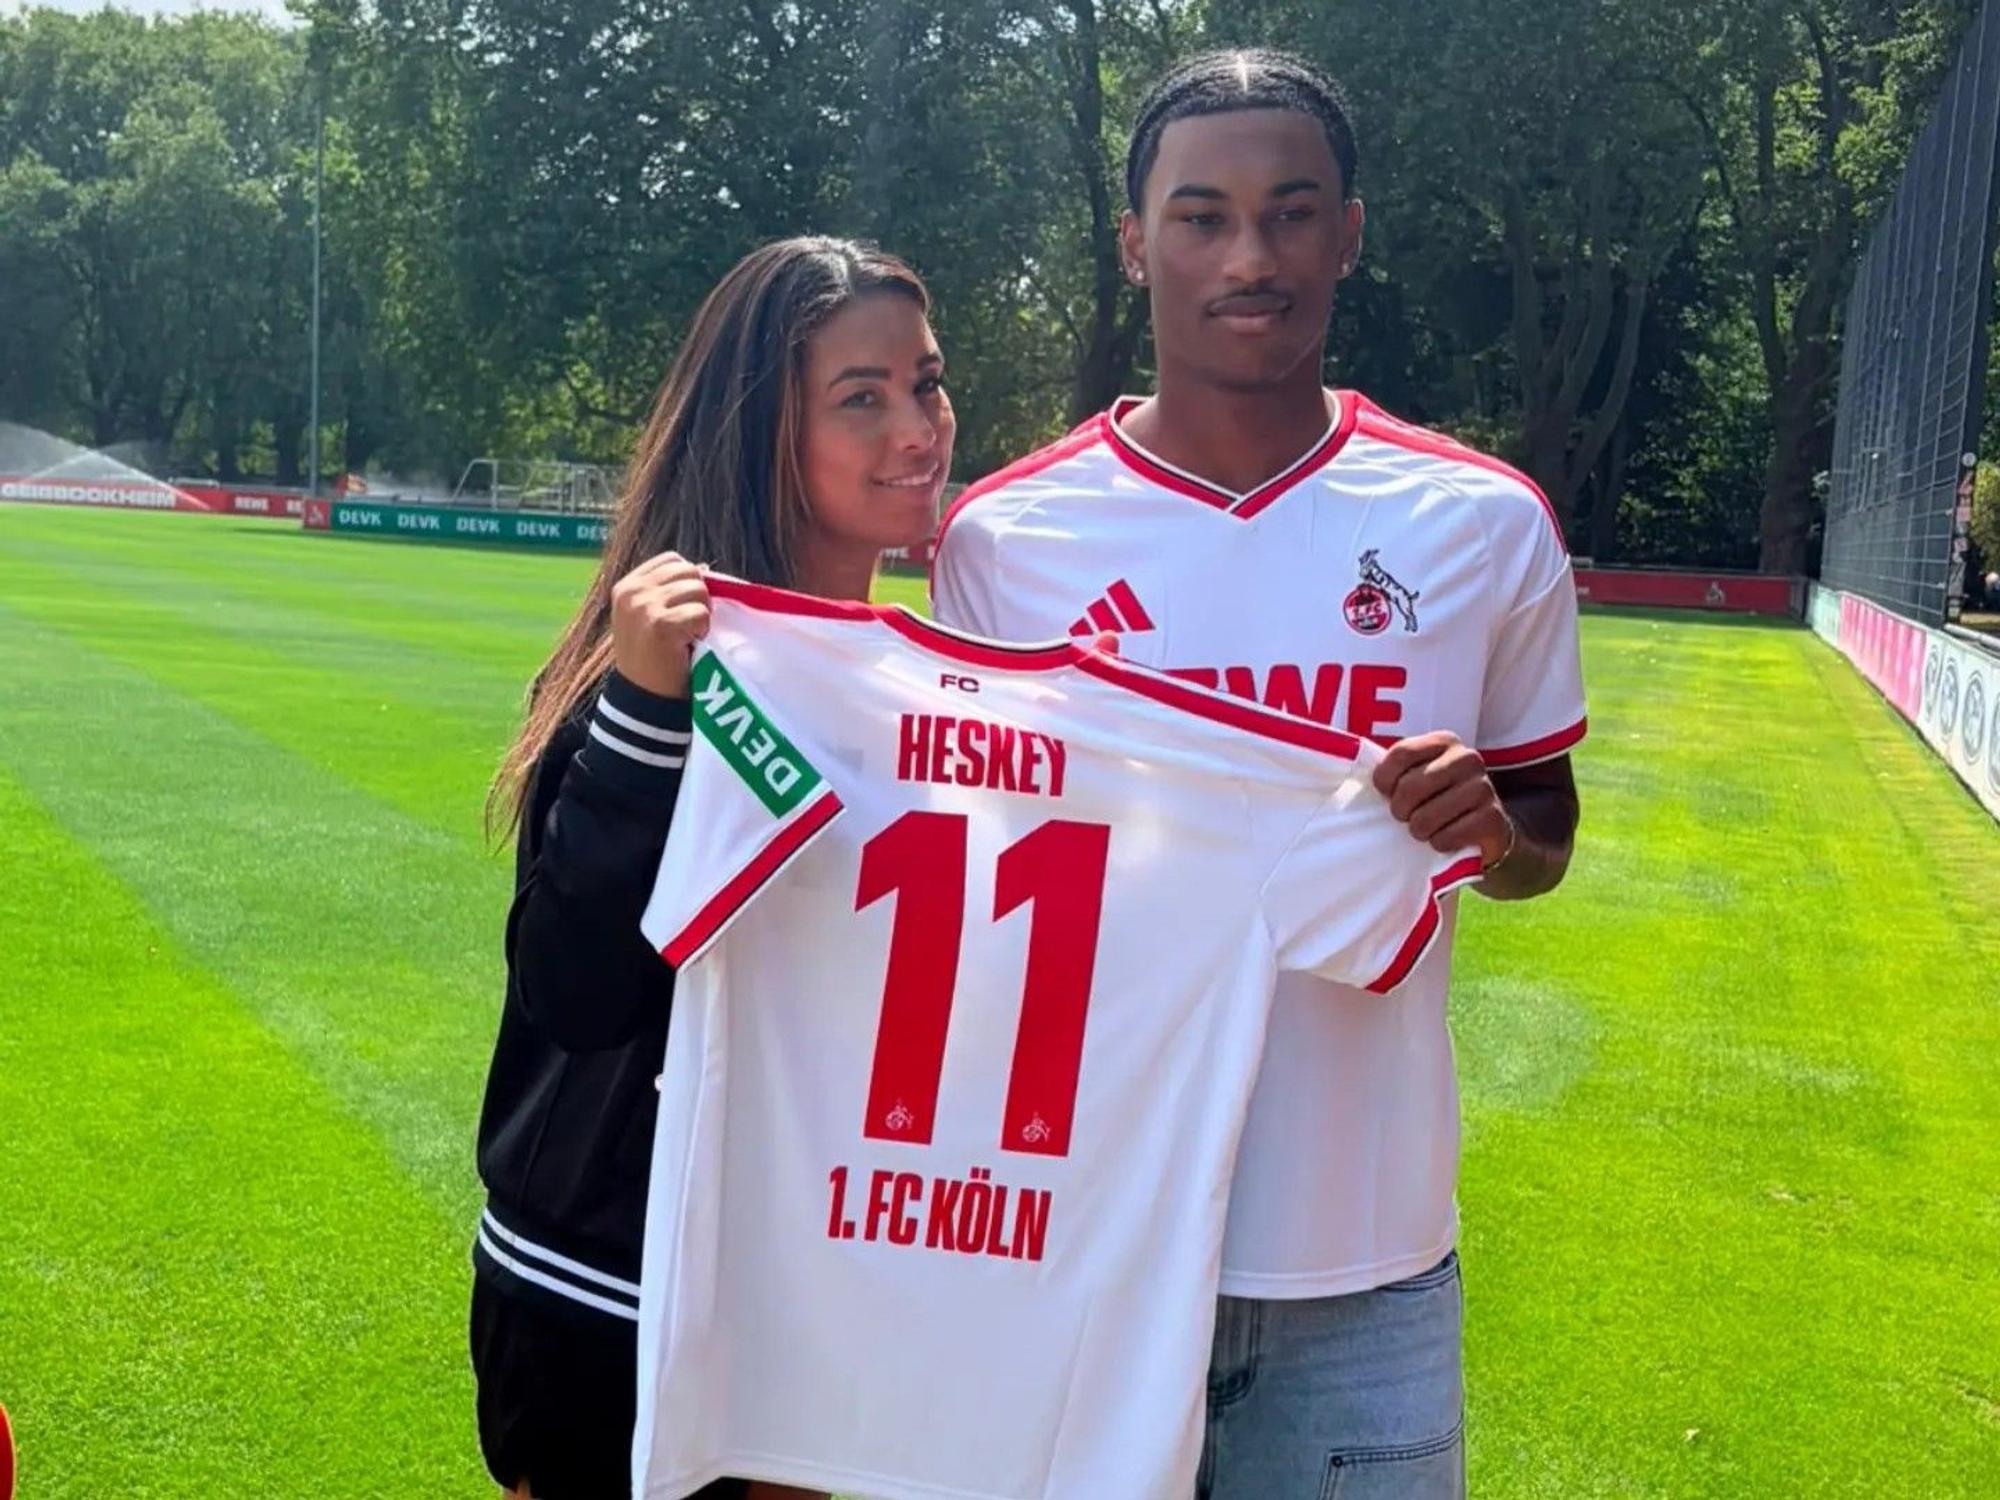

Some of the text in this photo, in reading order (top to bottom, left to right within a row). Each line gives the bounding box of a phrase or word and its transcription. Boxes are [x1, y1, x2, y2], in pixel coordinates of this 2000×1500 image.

[339, 509, 382, 526] DEVK
[397, 512, 440, 530] DEVK
[456, 516, 500, 533] DEVK
[516, 521, 561, 537] DEVK
[940, 673, 980, 694] FC
[694, 669, 802, 798] DEVK
[896, 713, 1067, 798] HESKEY
[854, 809, 1111, 1159] 11
[827, 1165, 1053, 1263] 1. FC KÖLN
